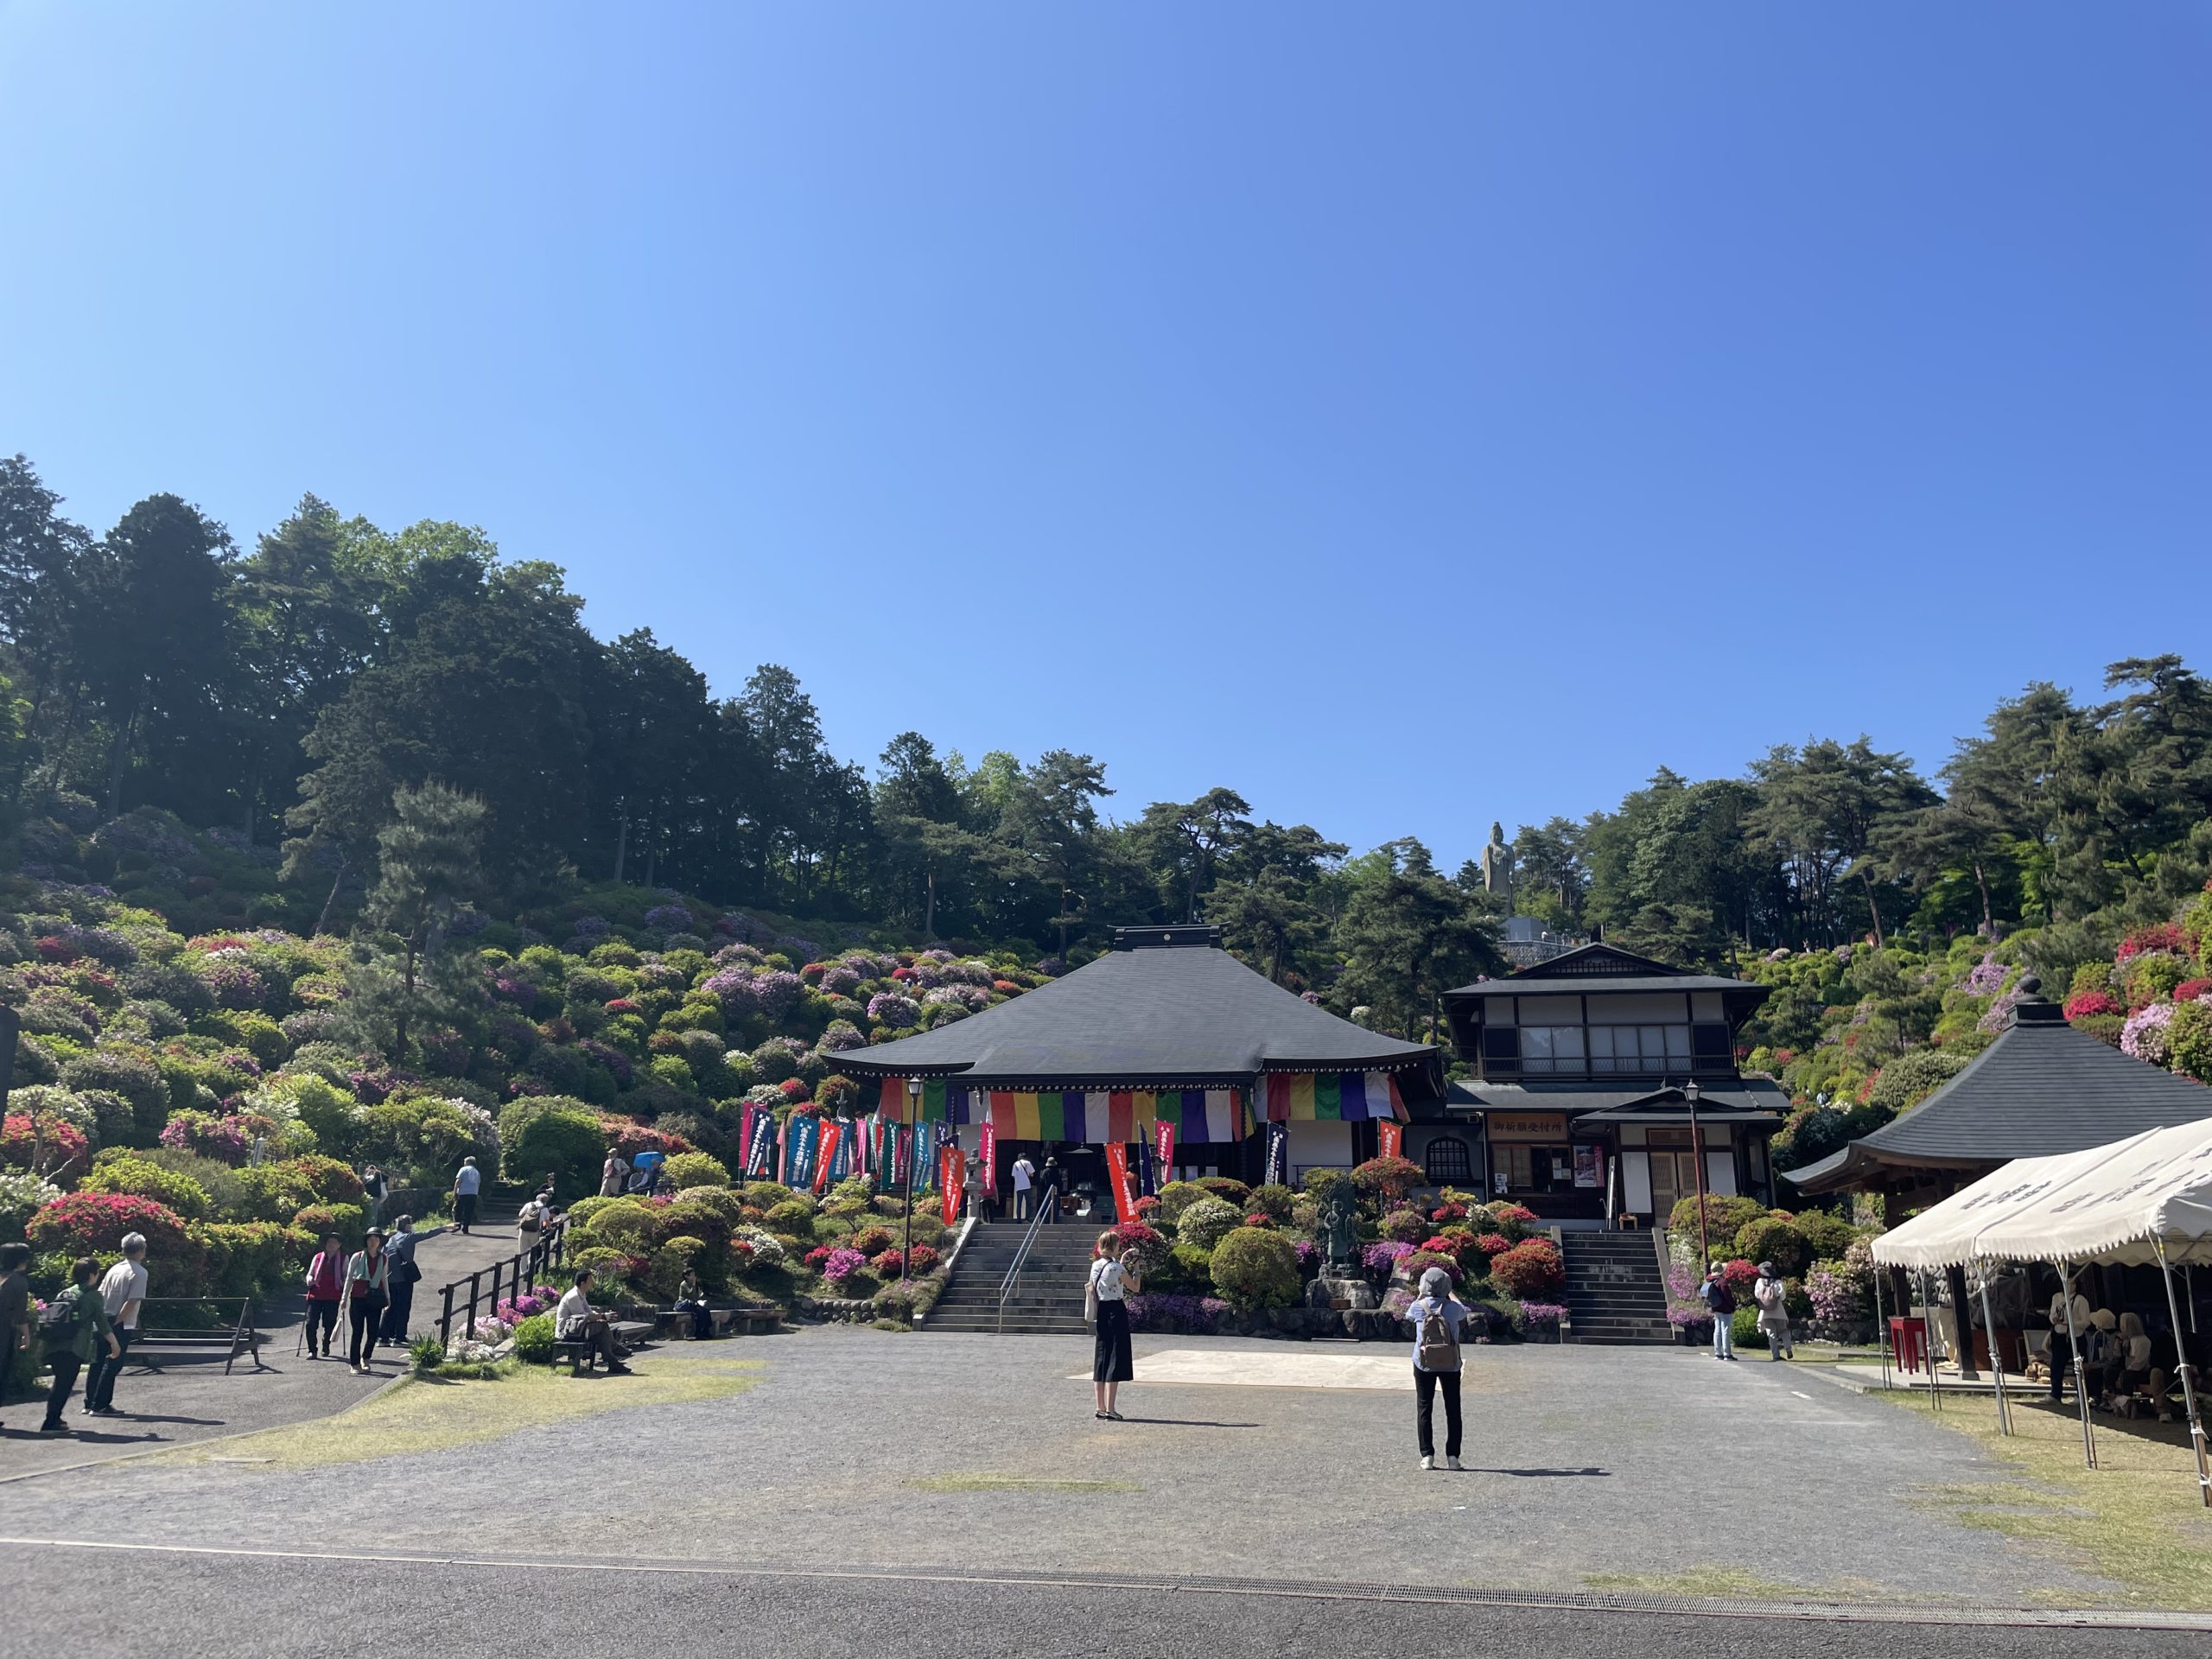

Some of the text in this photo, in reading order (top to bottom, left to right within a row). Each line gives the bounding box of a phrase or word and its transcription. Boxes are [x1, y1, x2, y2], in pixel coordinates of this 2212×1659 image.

[1494, 1122, 1562, 1133] 御祈願受付所
